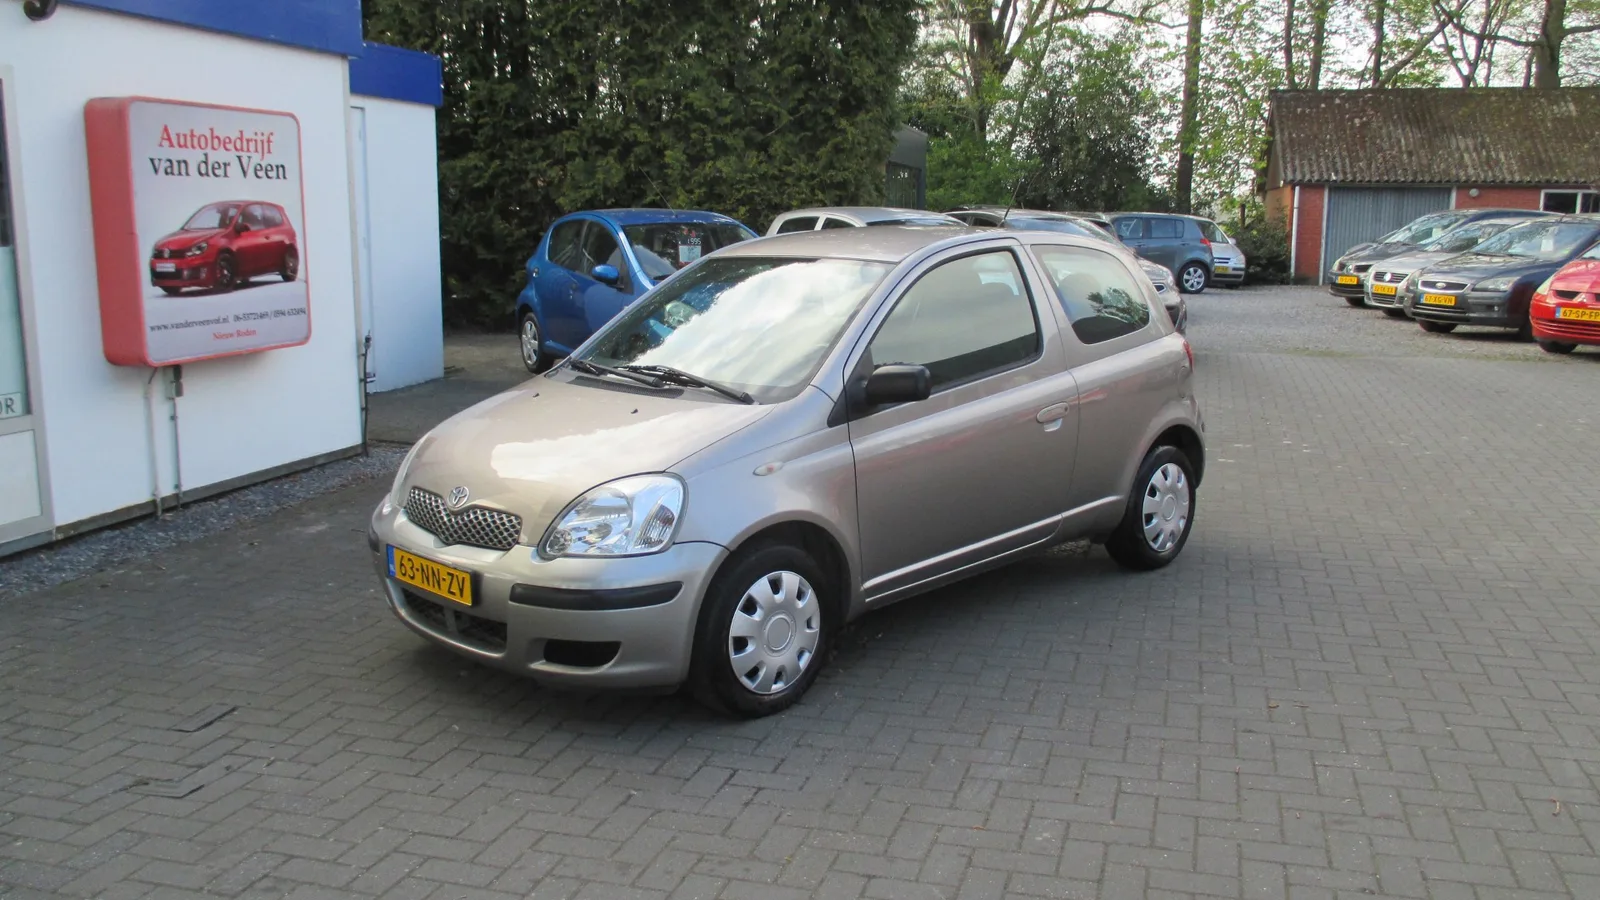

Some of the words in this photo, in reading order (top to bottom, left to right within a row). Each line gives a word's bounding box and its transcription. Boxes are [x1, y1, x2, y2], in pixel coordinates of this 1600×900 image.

[158, 124, 274, 161] Autobedrijf
[149, 157, 191, 176] van
[197, 152, 231, 178] der
[236, 155, 287, 180] Veen
[1562, 309, 1600, 320] 67-SP-FP
[0, 397, 15, 415] R
[400, 555, 465, 598] 63-NN-ZV
